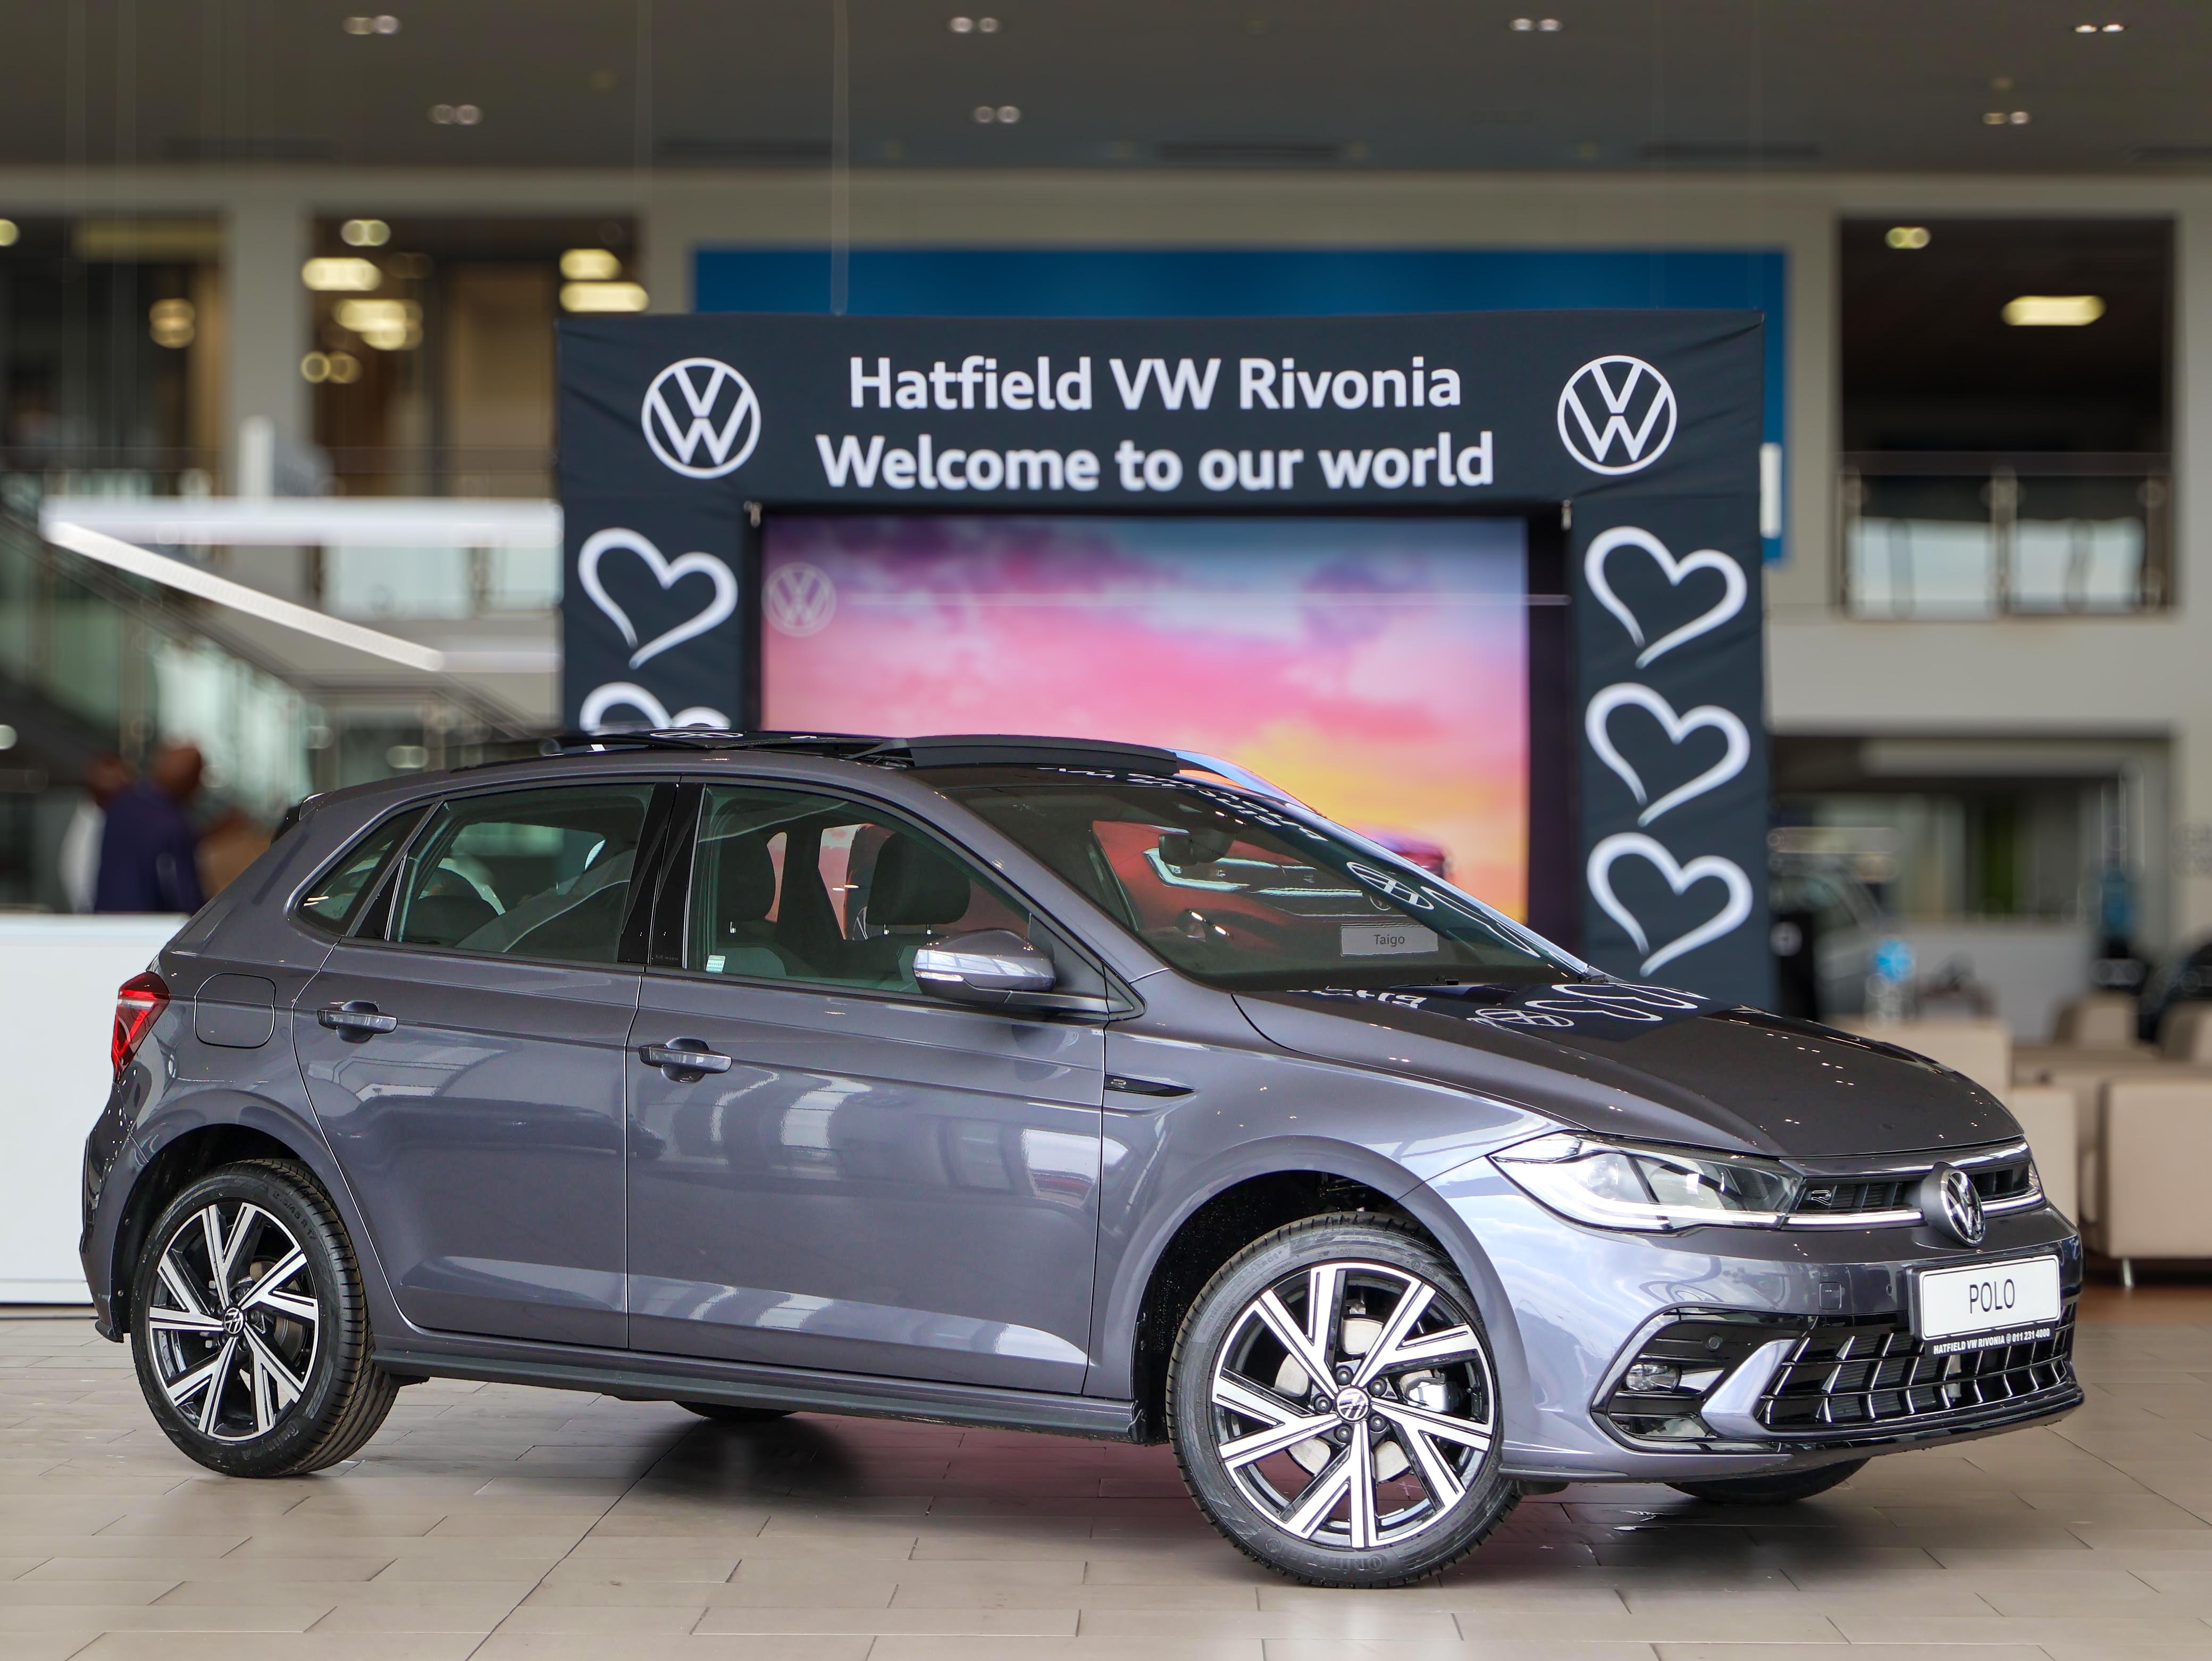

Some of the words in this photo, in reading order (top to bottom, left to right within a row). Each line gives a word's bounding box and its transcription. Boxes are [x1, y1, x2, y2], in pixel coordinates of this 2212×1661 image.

[851, 355, 1092, 410] Hatfield
[1109, 358, 1221, 410] VW
[1240, 356, 1461, 409] Rivonia
[641, 357, 761, 479] VW
[1557, 355, 1677, 475] VW
[815, 434, 1100, 491] Welcome
[1115, 440, 1183, 491] to
[1199, 449, 1304, 491] our
[1318, 431, 1493, 489] world
[1373, 934, 1405, 946] Taigo
[1969, 1278, 2015, 1314] POLO
[1933, 1340, 1966, 1354] HATFIELD
[1966, 1339, 1978, 1349] VW
[1978, 1335, 2005, 1348] RIVONIA
[2012, 1332, 2023, 1343] 011
[2024, 1330, 2034, 1340] 231
[2035, 1328, 2050, 1339] 4000
